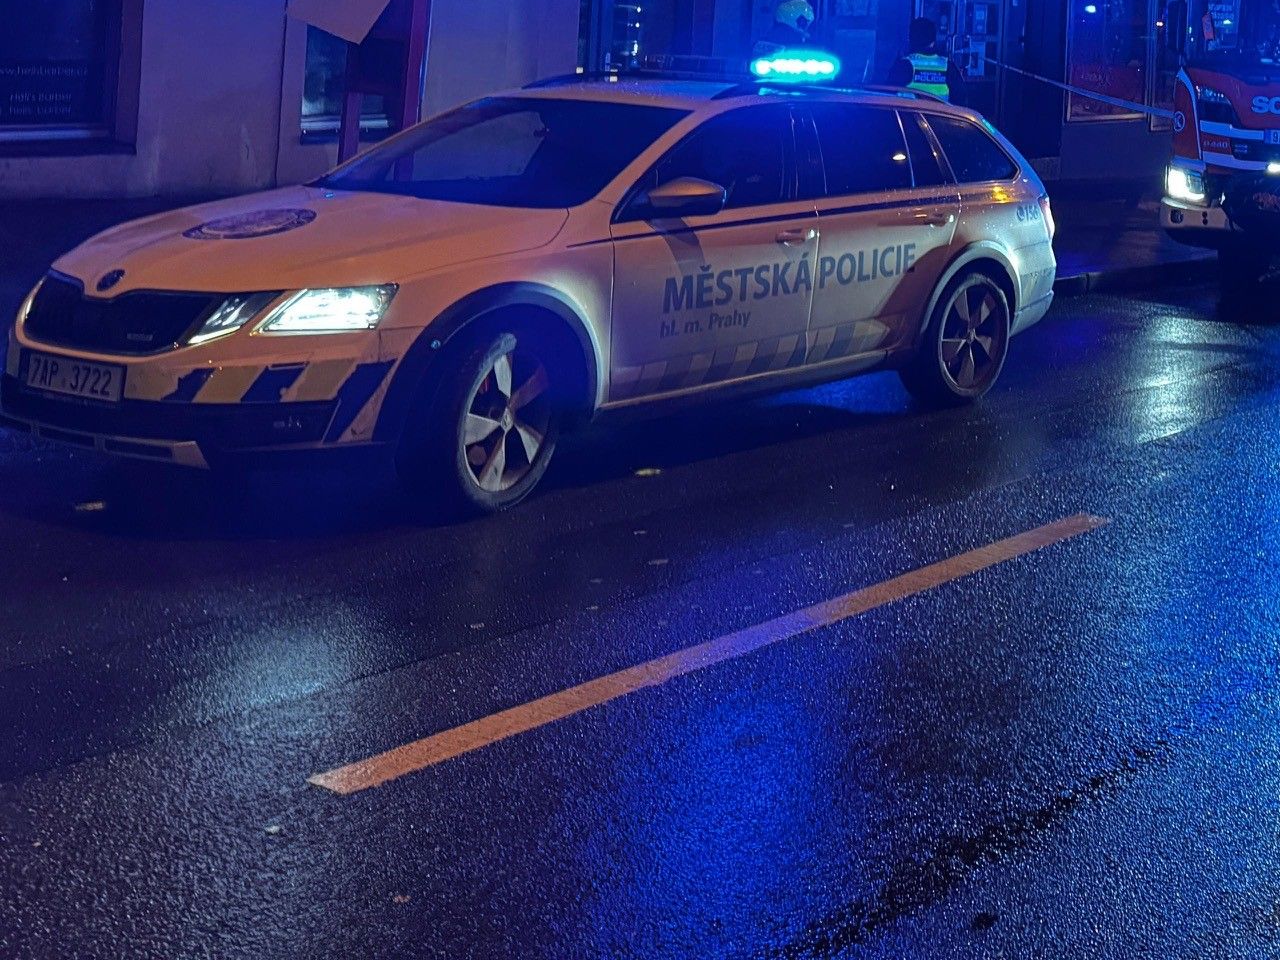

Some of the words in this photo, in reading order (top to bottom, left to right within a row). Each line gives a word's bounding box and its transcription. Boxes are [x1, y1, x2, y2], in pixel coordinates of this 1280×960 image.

[662, 252, 812, 314] MĚSTSKÁ
[819, 243, 917, 289] POLICIE
[660, 319, 680, 338] hl.
[684, 319, 703, 334] m.
[708, 309, 751, 330] Prahy
[31, 357, 59, 386] 7AP
[70, 365, 112, 397] 3722
